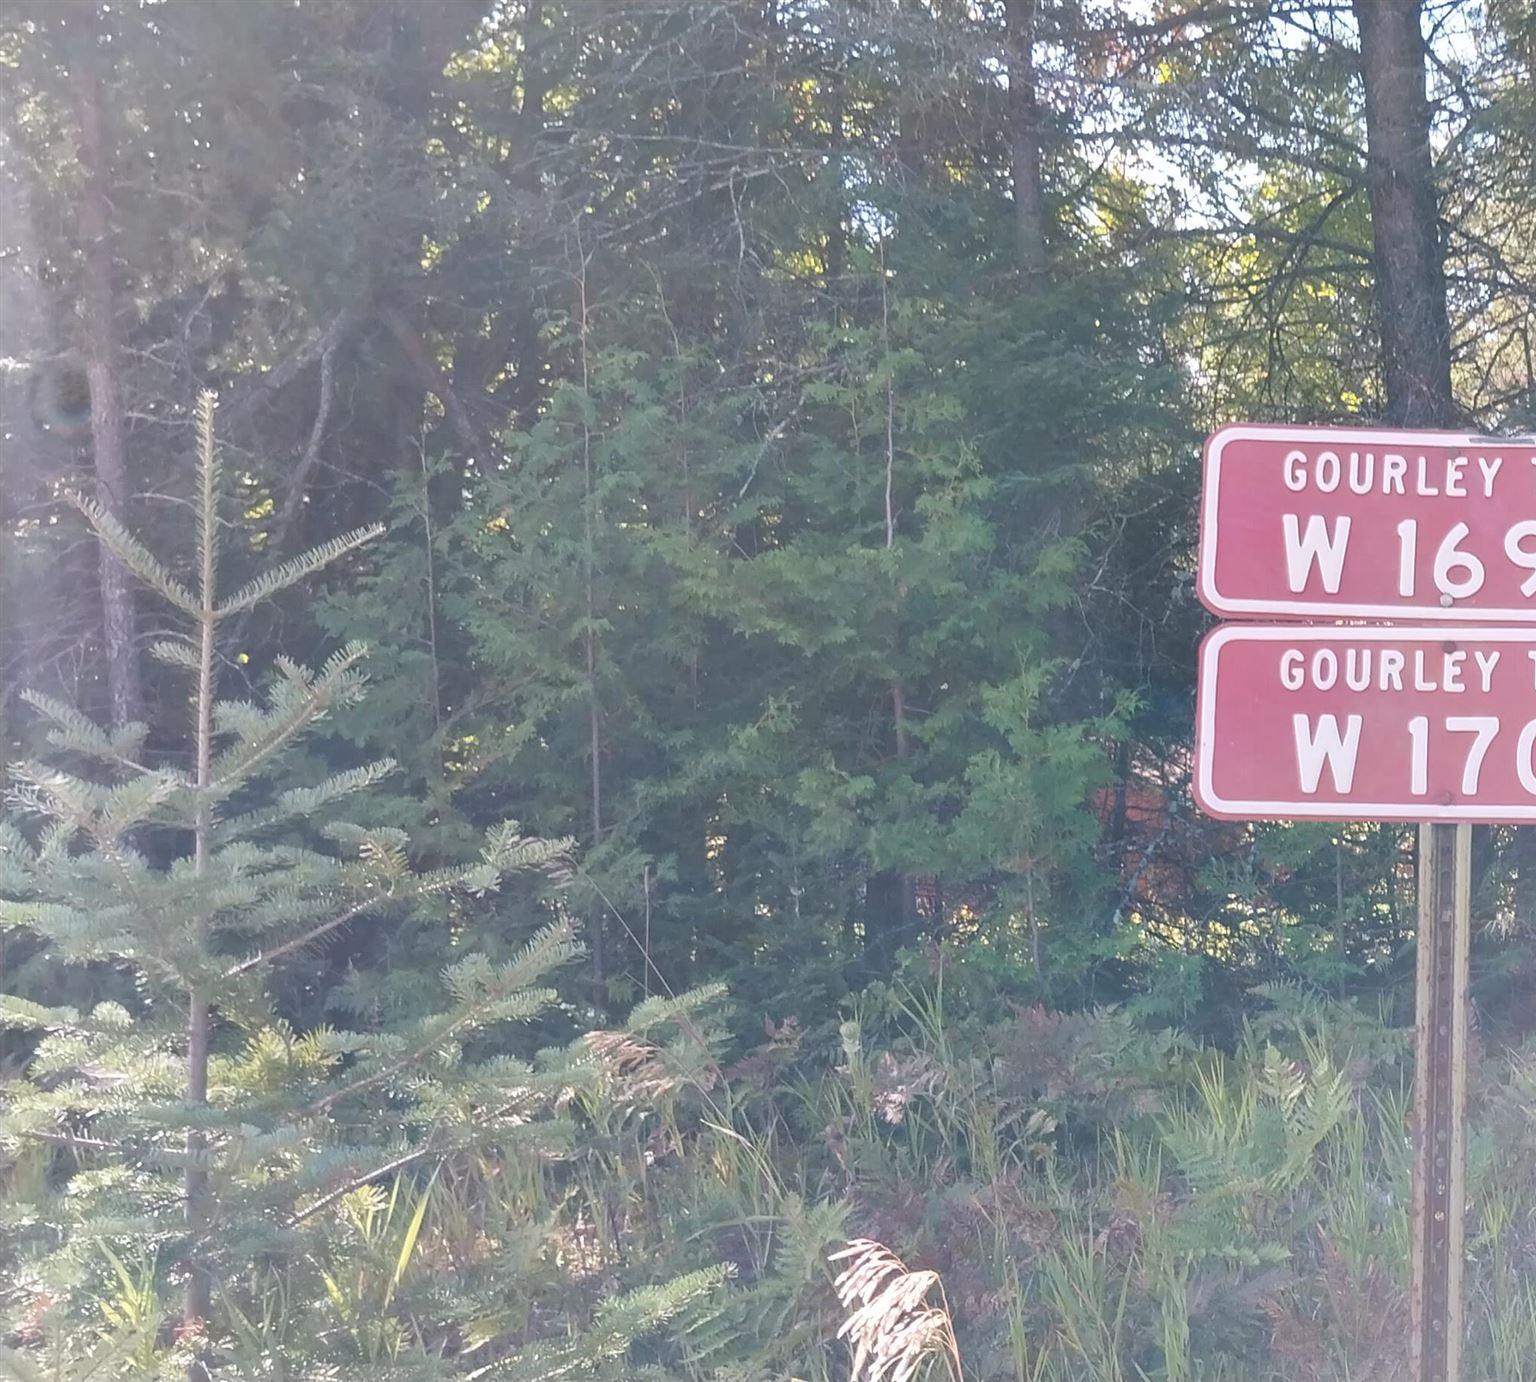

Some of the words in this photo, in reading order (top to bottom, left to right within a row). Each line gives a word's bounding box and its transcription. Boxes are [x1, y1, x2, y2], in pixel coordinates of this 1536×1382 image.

[1283, 451, 1502, 497] GOURLEY
[1282, 514, 1351, 593] W
[1279, 649, 1501, 692] GOURLEY
[1293, 714, 1363, 794] W
